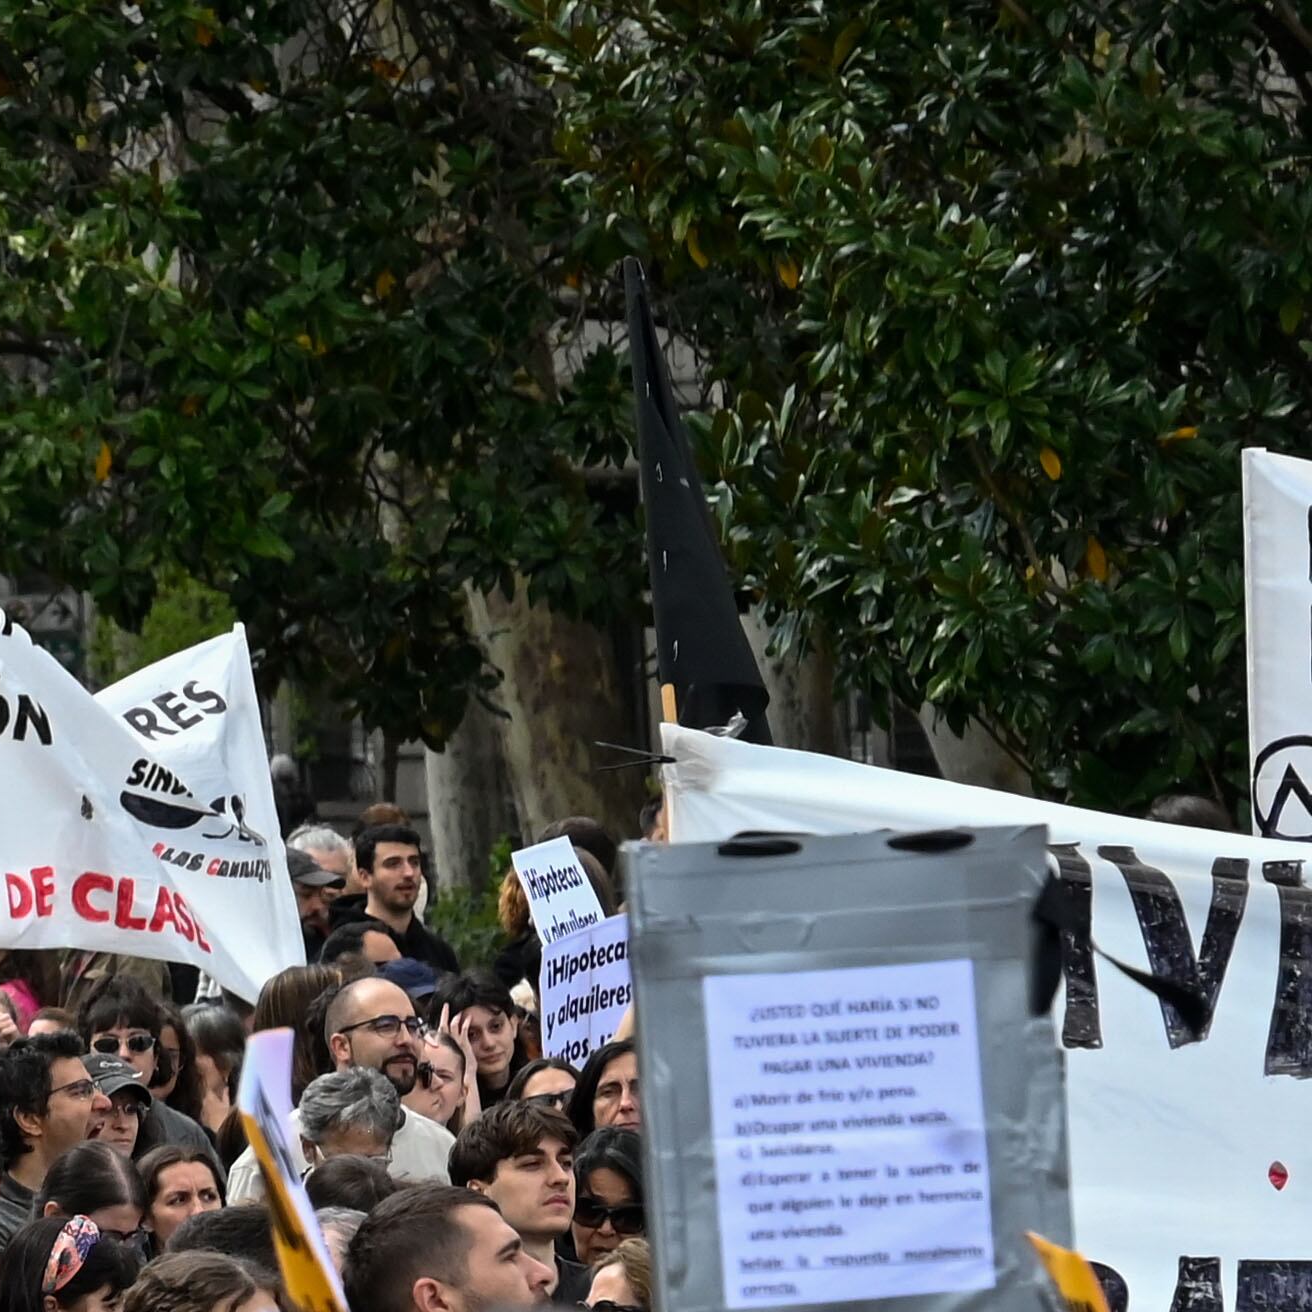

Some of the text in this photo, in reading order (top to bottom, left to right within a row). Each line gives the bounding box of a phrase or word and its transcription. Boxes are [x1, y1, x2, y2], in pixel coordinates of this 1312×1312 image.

[5, 866, 56, 920] DE
[71, 870, 214, 955] CLASE
[546, 983, 631, 1041] y alquileres
[908, 1022, 960, 1038] PODER
